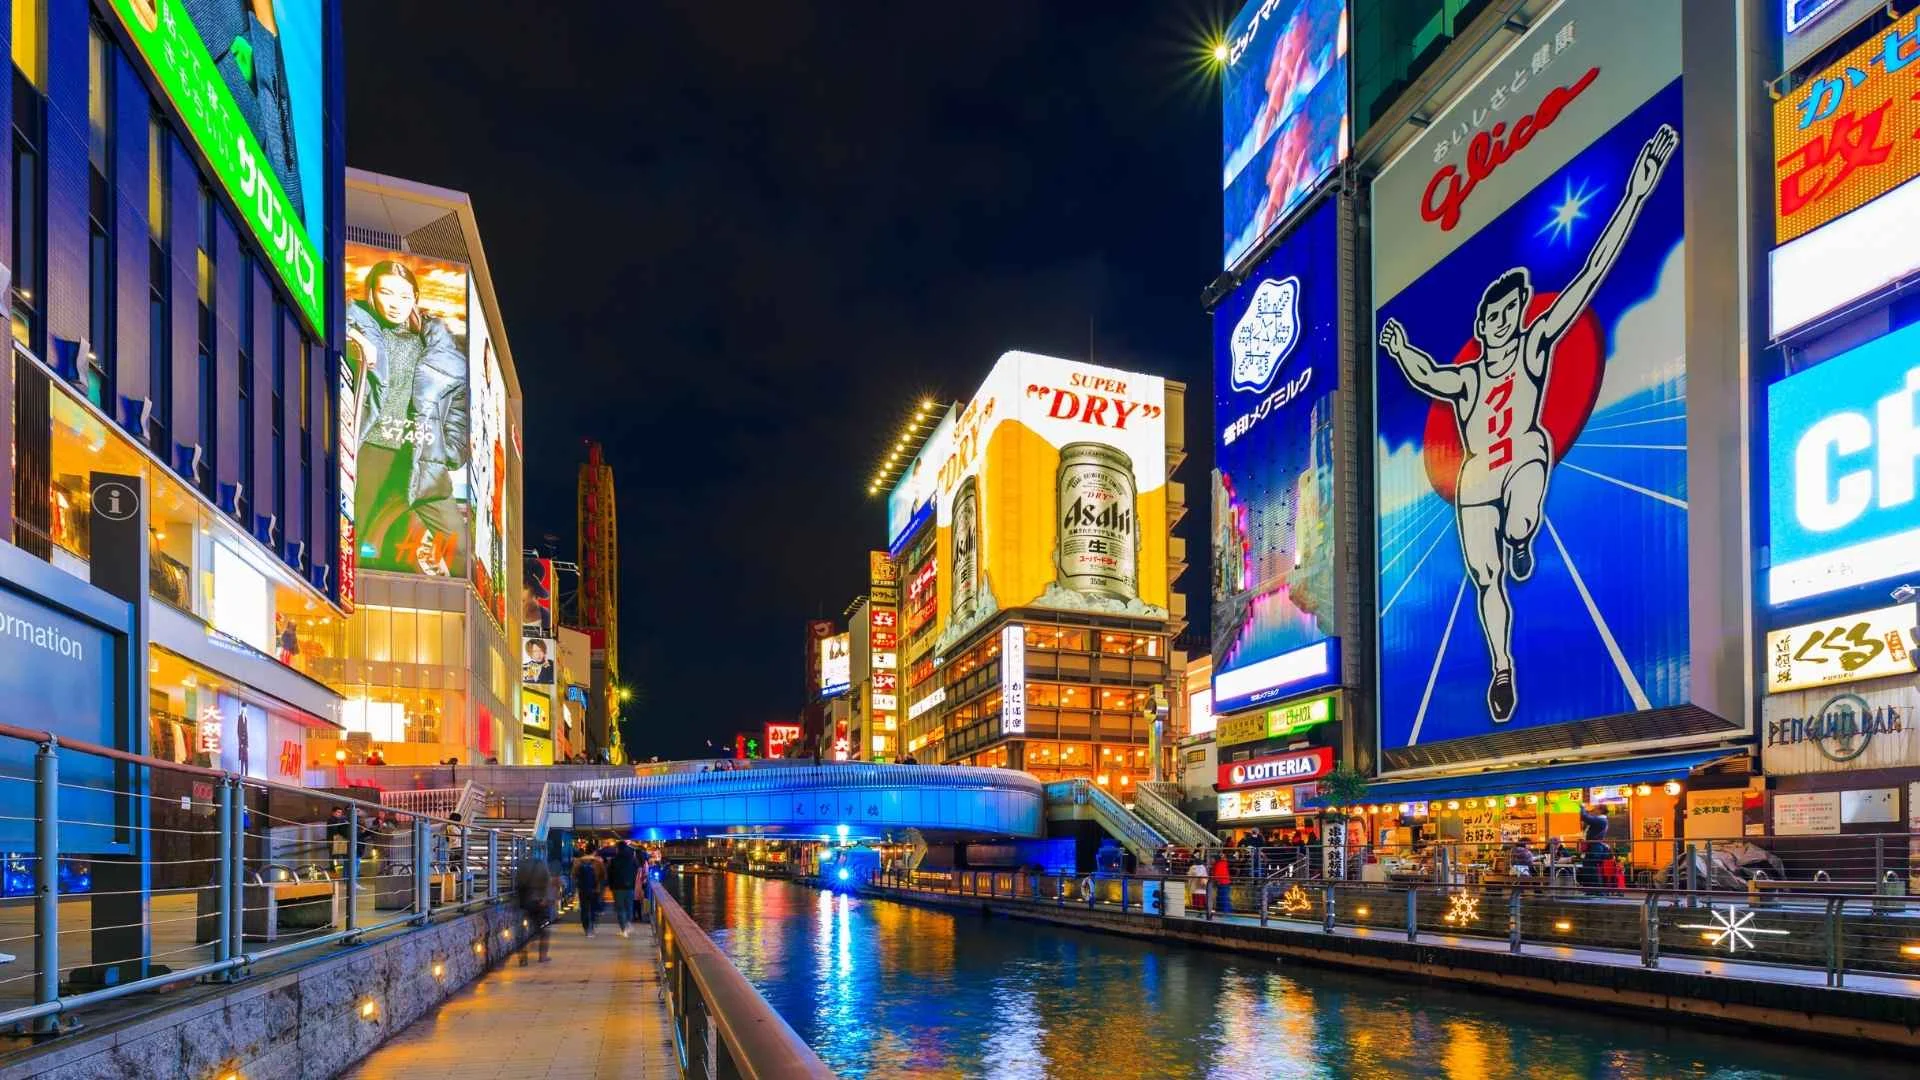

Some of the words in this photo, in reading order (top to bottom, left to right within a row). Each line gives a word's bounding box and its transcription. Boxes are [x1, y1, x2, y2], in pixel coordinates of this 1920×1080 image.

[1433, 20, 1576, 163] おいしさと健康
[1420, 66, 1601, 232] Glico
[1776, 85, 1920, 218] 改
[238, 135, 316, 308] サロンパス
[1070, 371, 1128, 395] SUPER
[1223, 367, 1313, 447] 雪印メグミルク
[1483, 370, 1516, 472] グリコ
[1063, 496, 1131, 536] Asahi
[1088, 539, 1108, 555] 生
[1793, 621, 1885, 672] くくる
[1247, 757, 1312, 781] LOTTERIA
[1465, 828, 1494, 842] お好み
